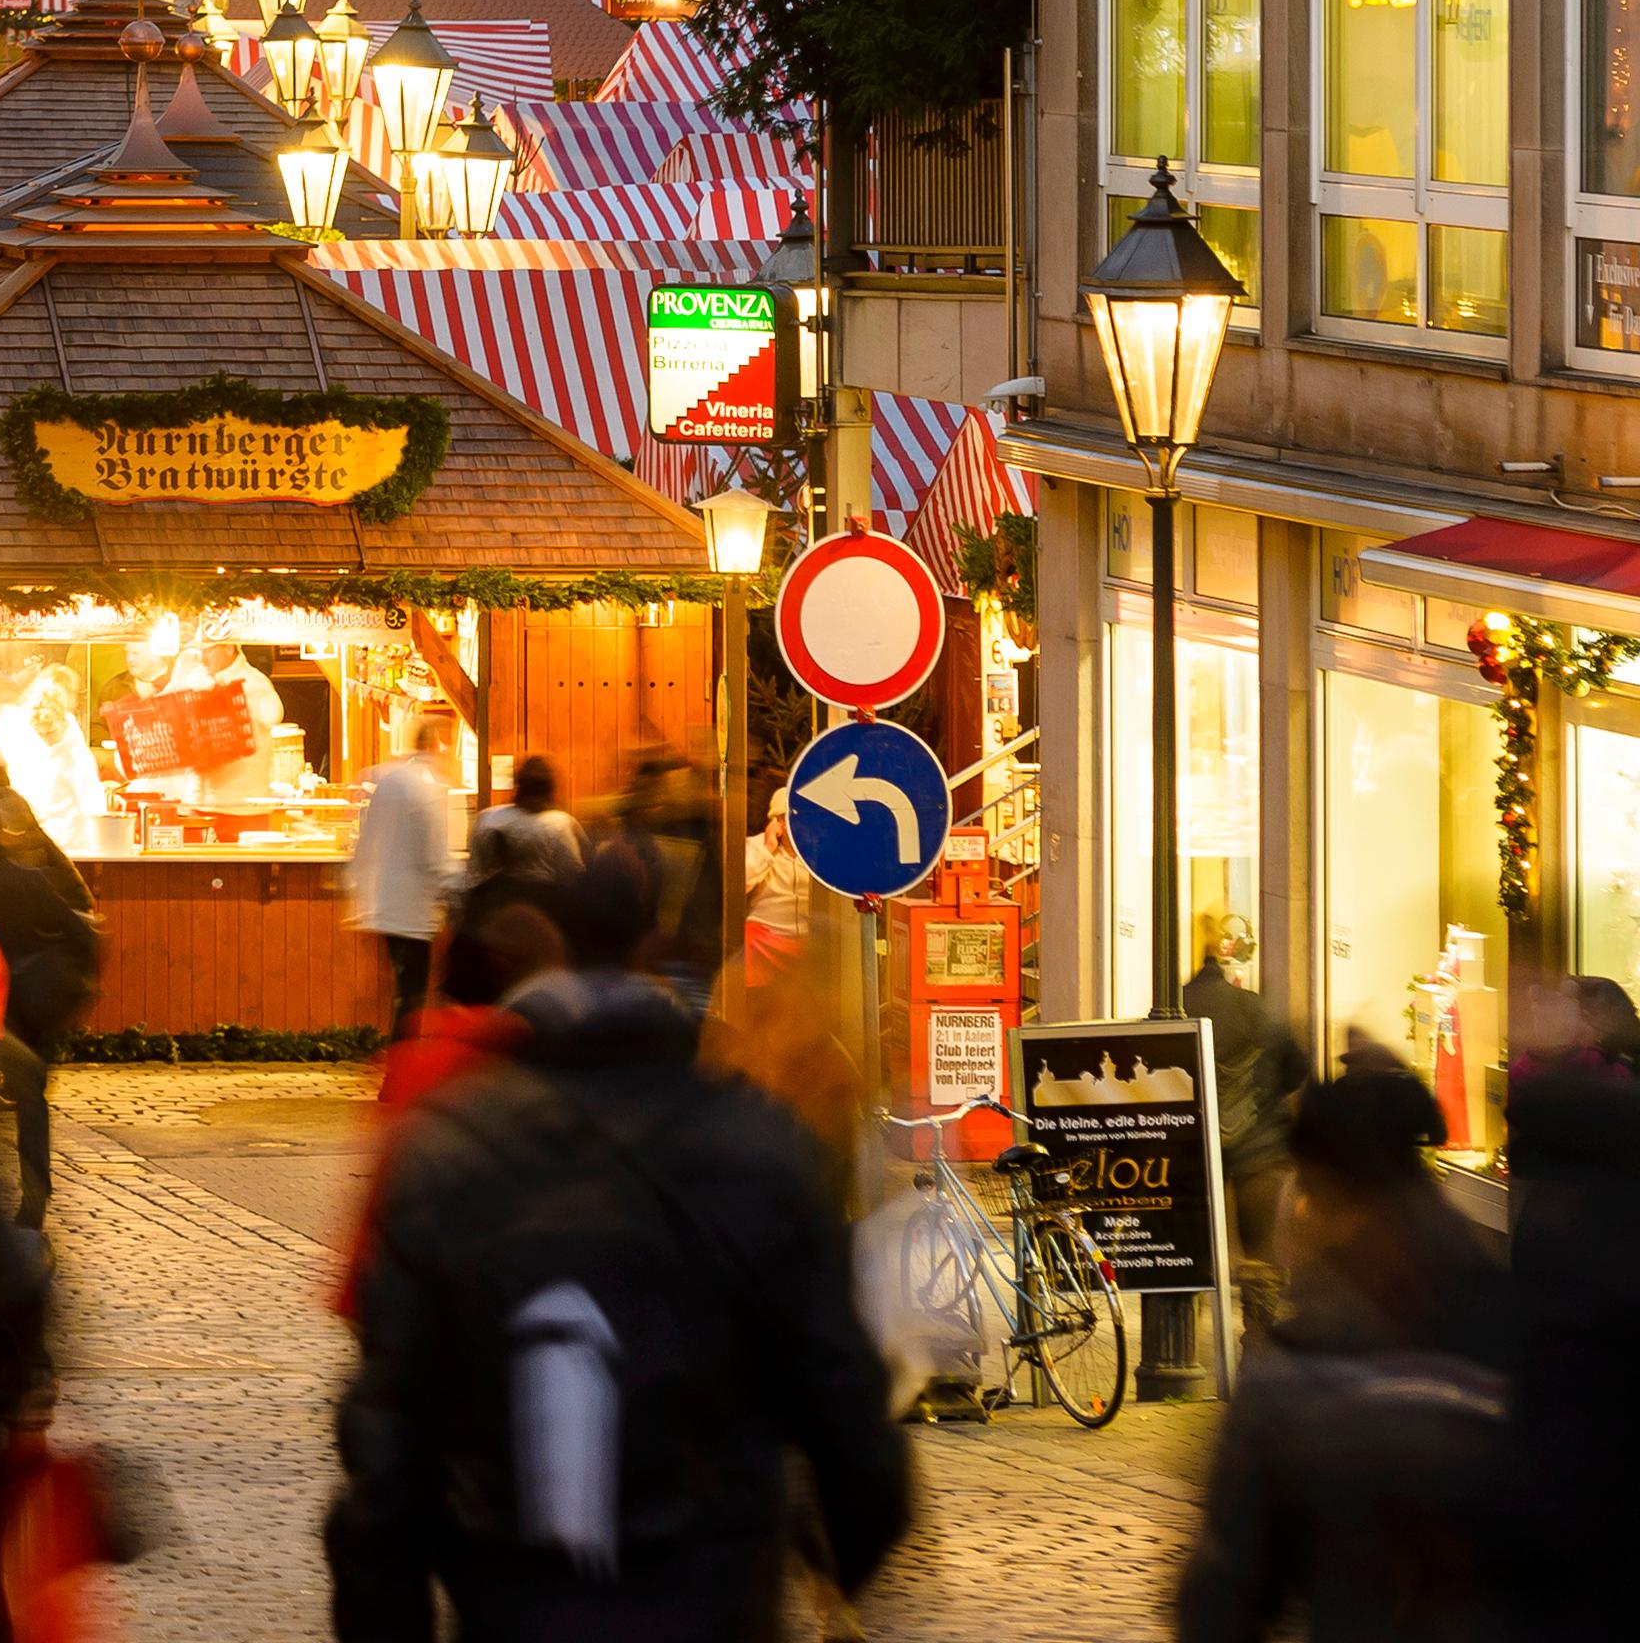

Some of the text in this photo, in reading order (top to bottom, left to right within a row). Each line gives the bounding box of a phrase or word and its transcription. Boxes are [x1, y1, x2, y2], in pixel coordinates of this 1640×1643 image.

[651, 291, 773, 317] PROVENZA
[653, 356, 726, 371] Birreria
[706, 401, 773, 418] Vineria
[679, 421, 773, 438] Cafetteria
[96, 457, 348, 491] Bratwürste
[936, 1044, 996, 1057] Club feiert
[935, 1058, 996, 1072] Doppelpack
[935, 1071, 996, 1087] von Füllkrug
[1035, 1118, 1057, 1130] Die
[1105, 1115, 1136, 1127] edle
[1137, 1113, 1196, 1128] Boutique
[1104, 1216, 1140, 1227] Mode
